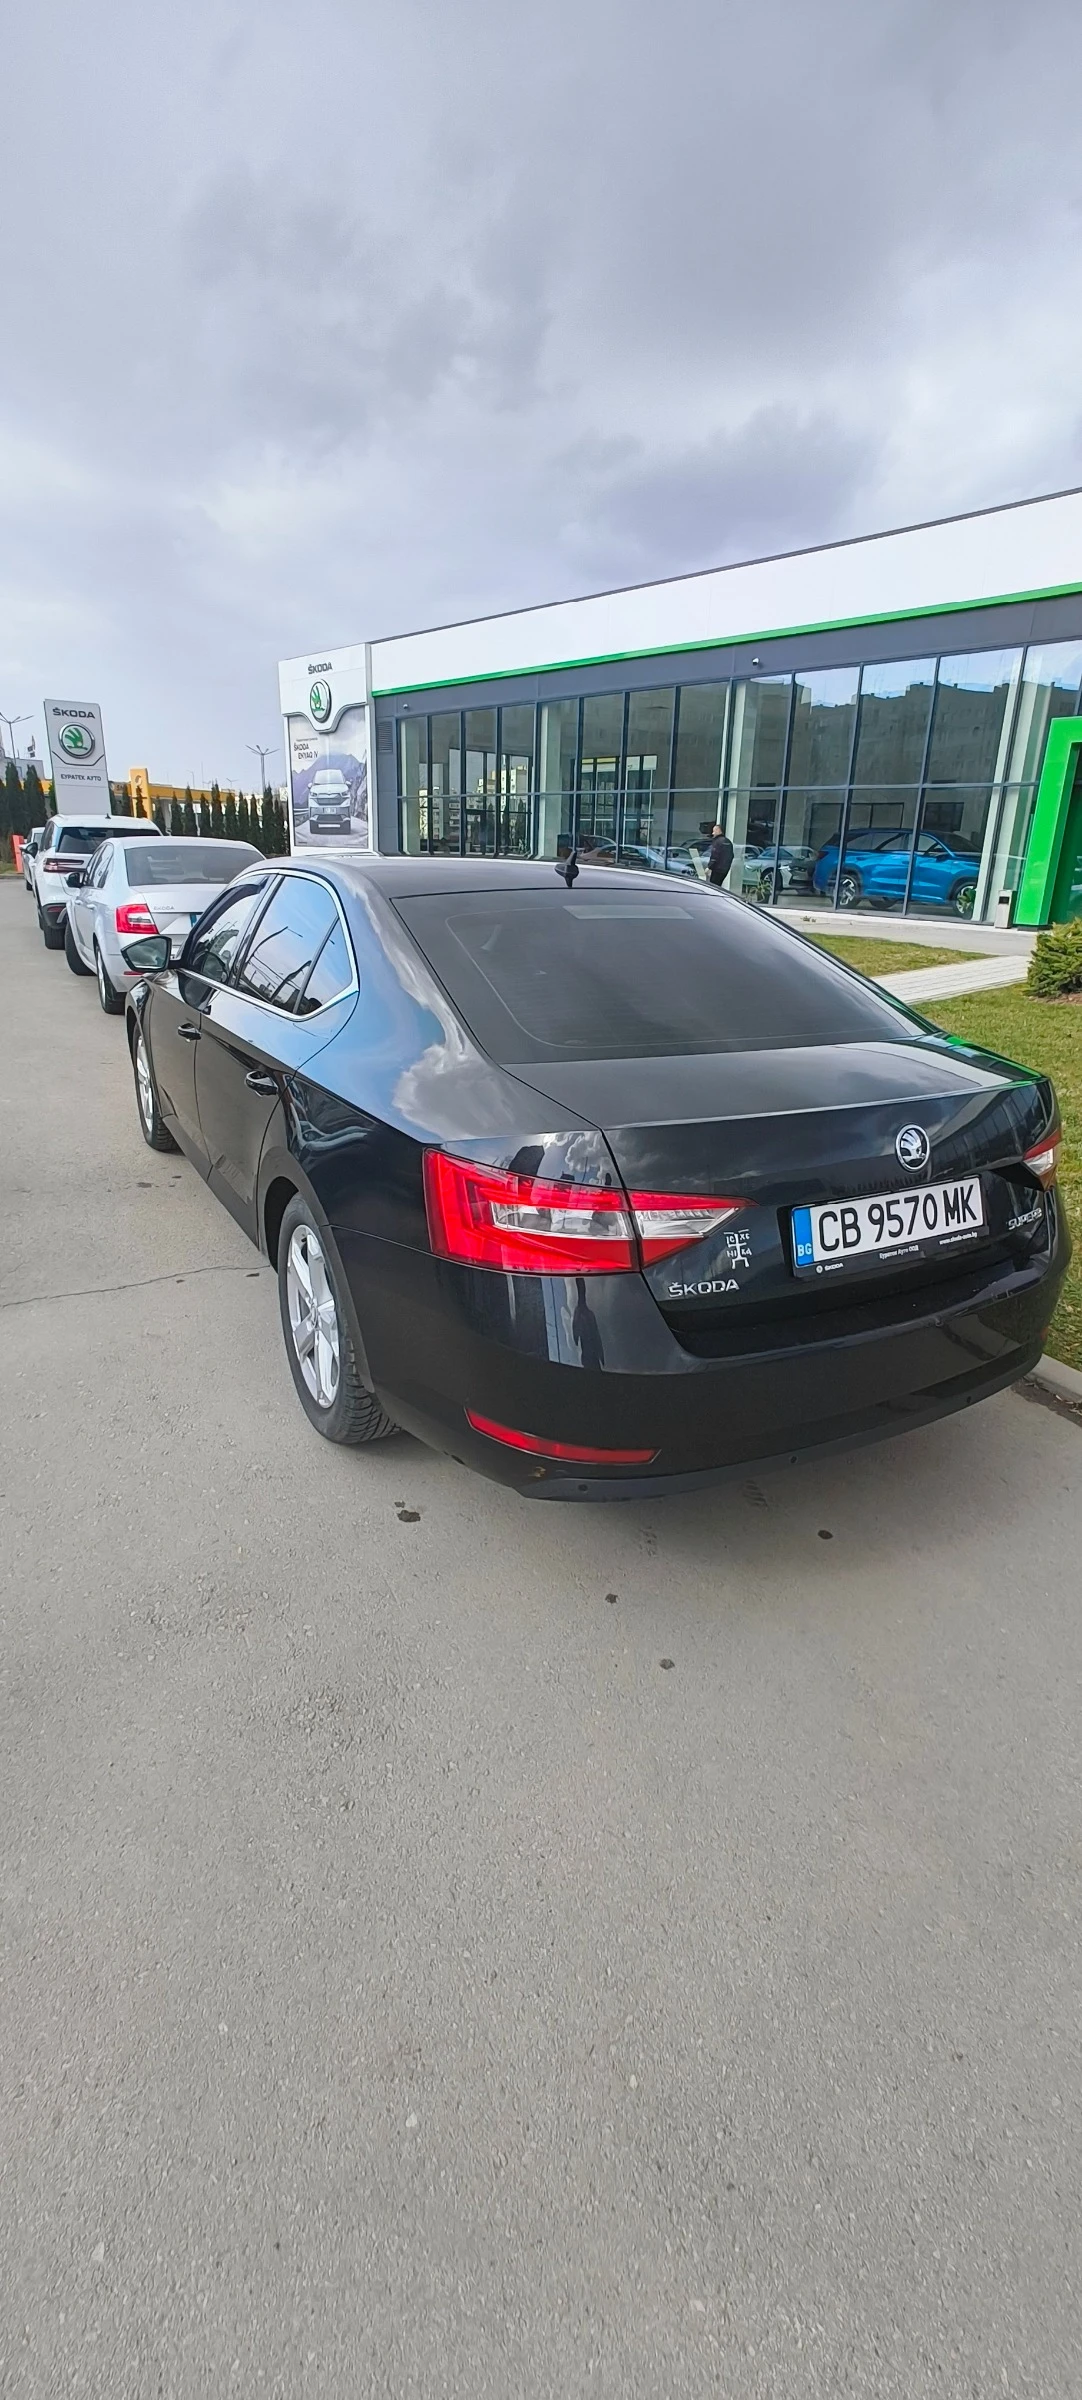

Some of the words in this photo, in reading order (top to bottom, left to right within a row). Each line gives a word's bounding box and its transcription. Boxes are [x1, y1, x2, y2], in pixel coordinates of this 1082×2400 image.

[307, 662, 333, 675] ŠKODA
[52, 706, 96, 719] ŠKODA
[818, 1206, 862, 1252] CB
[867, 1193, 938, 1244] 9570
[943, 1184, 978, 1227] MK
[797, 1244, 812, 1257] BG
[668, 1278, 740, 1298] ŠKODA
